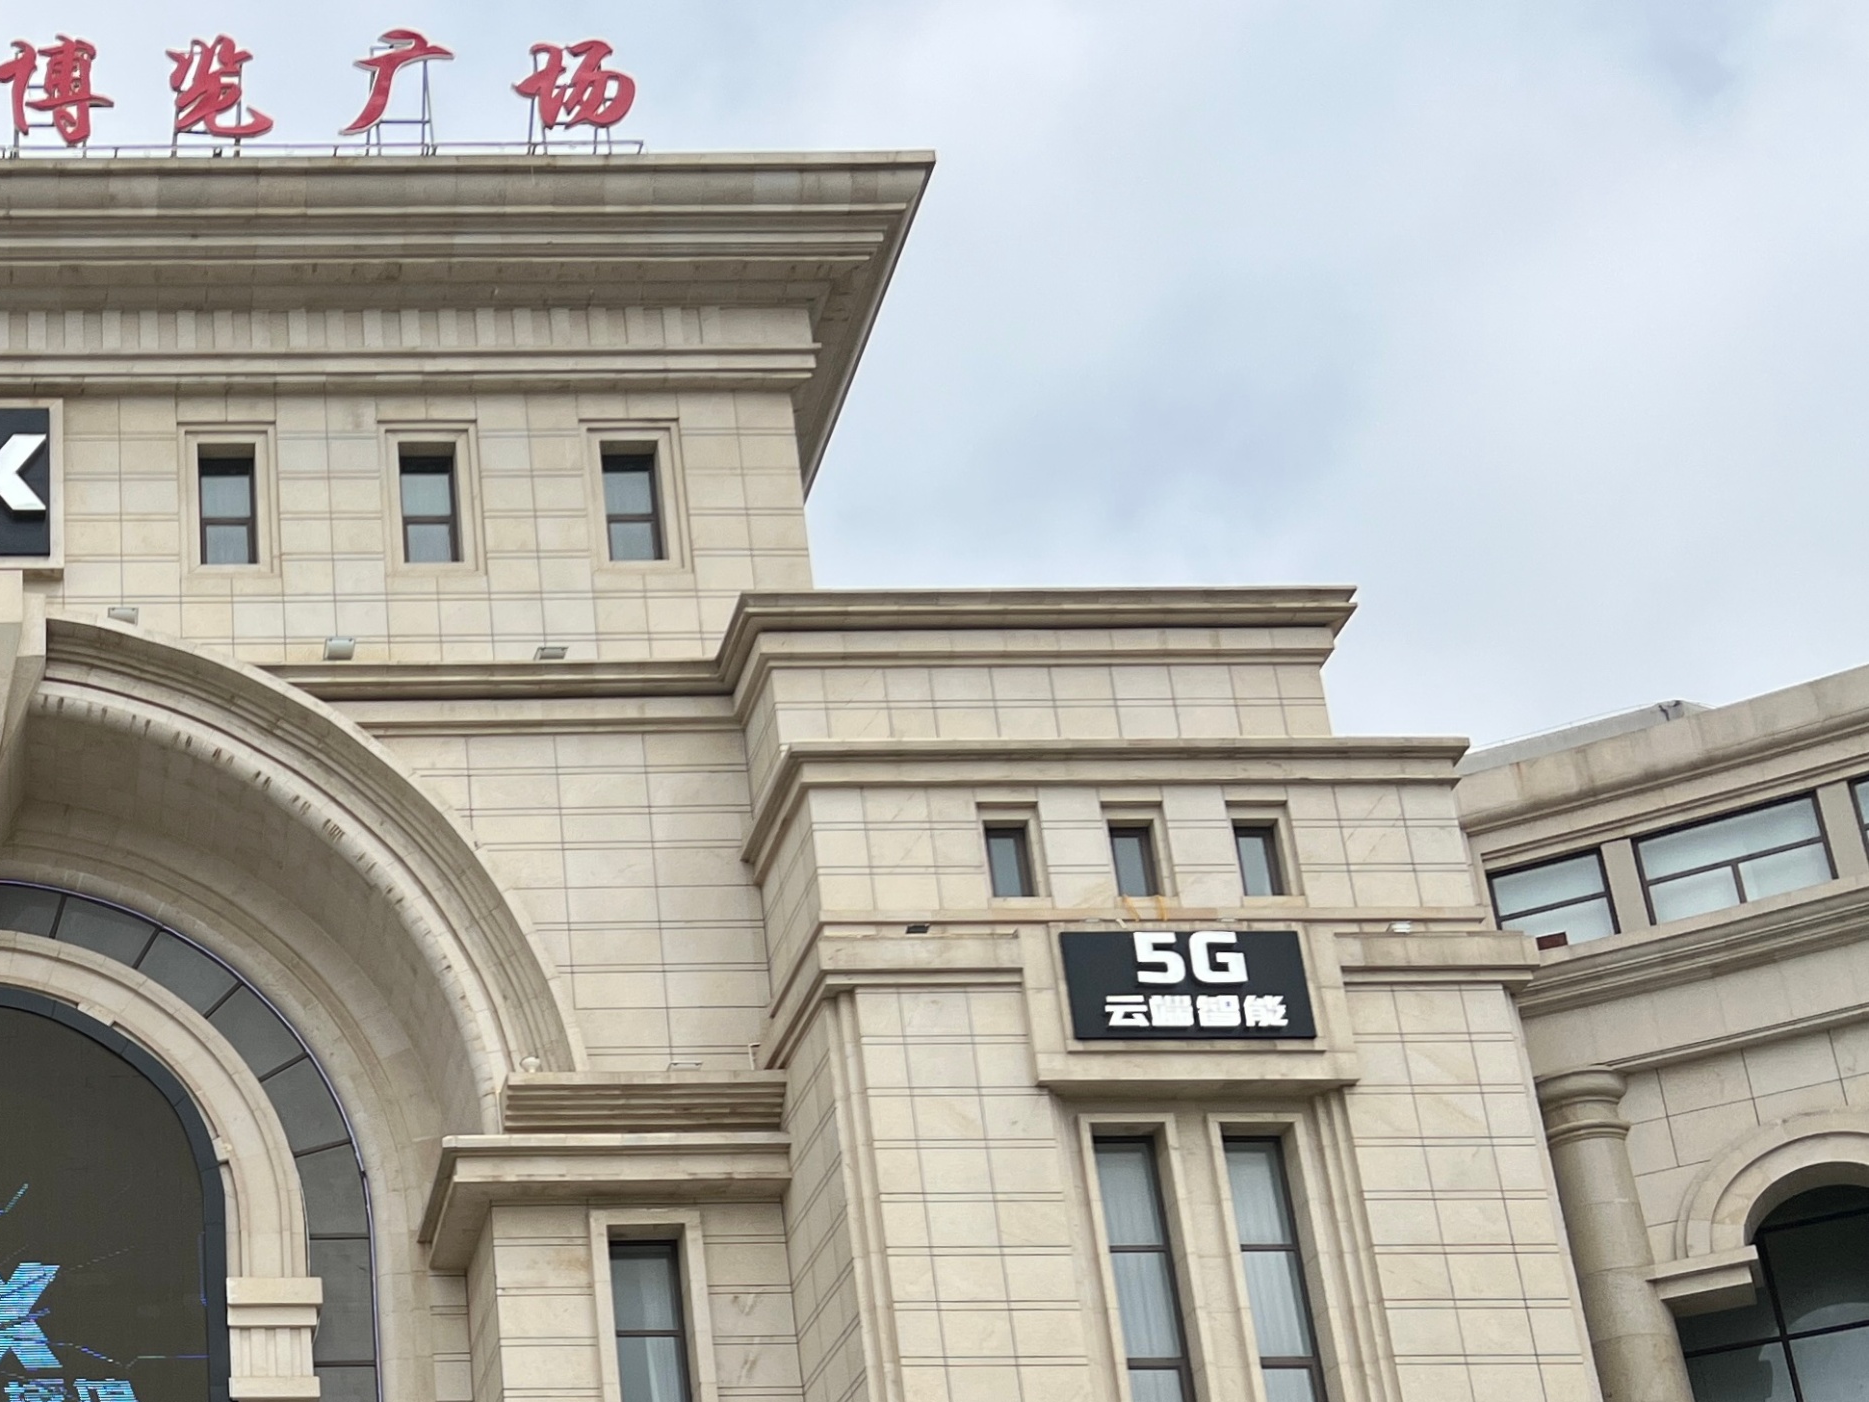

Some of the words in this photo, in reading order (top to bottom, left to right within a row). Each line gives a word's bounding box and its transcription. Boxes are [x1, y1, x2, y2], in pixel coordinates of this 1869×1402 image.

[1133, 931, 1249, 984] 5G
[1104, 995, 1289, 1027] 云端智能
